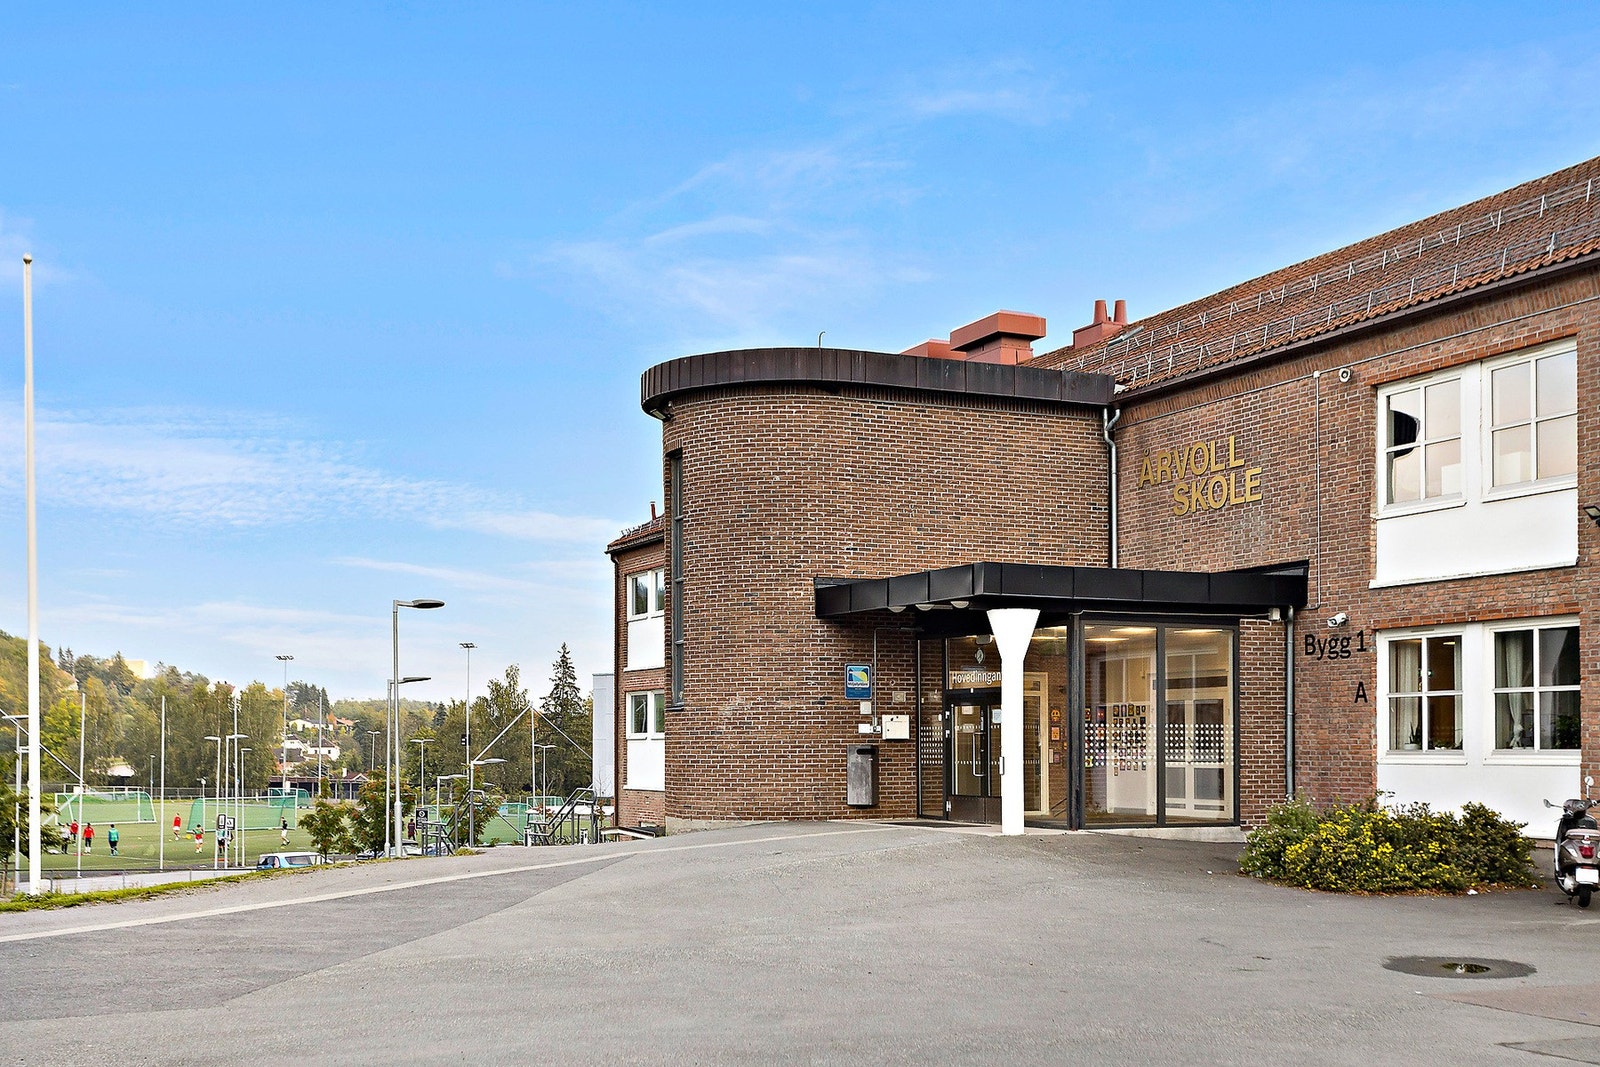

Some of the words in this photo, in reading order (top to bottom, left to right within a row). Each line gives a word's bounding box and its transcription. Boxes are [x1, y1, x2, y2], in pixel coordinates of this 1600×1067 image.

[1138, 435, 1245, 488] ÅRVOLL
[1173, 467, 1262, 516] SKOLE
[1304, 634, 1351, 661] Bygg
[1356, 629, 1367, 652] 1
[952, 670, 1002, 685] Hovedinngan
[1354, 681, 1368, 703] A
